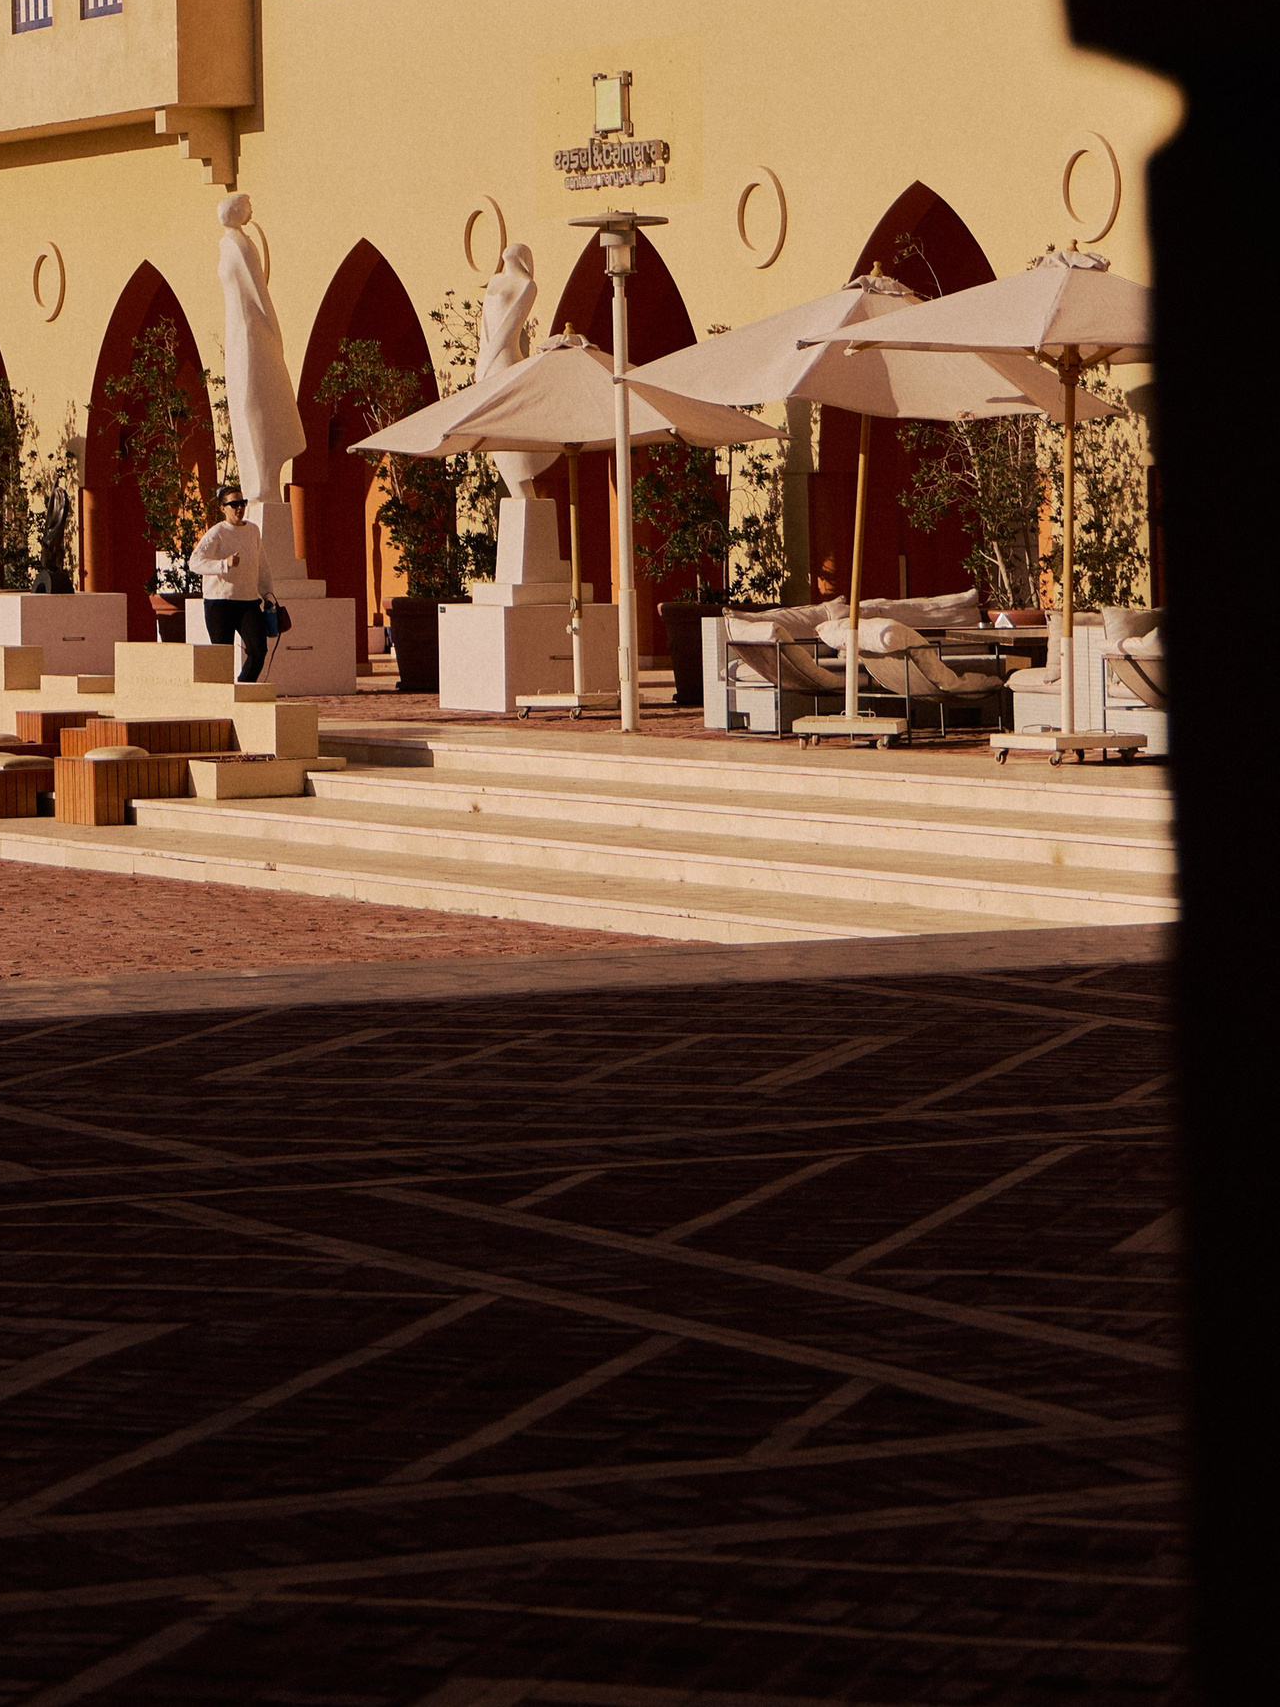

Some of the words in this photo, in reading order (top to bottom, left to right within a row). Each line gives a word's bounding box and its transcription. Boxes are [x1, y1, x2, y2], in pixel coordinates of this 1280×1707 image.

[564, 172, 620, 189] contemporary
[619, 171, 633, 185] art
[633, 167, 662, 184] gallery
